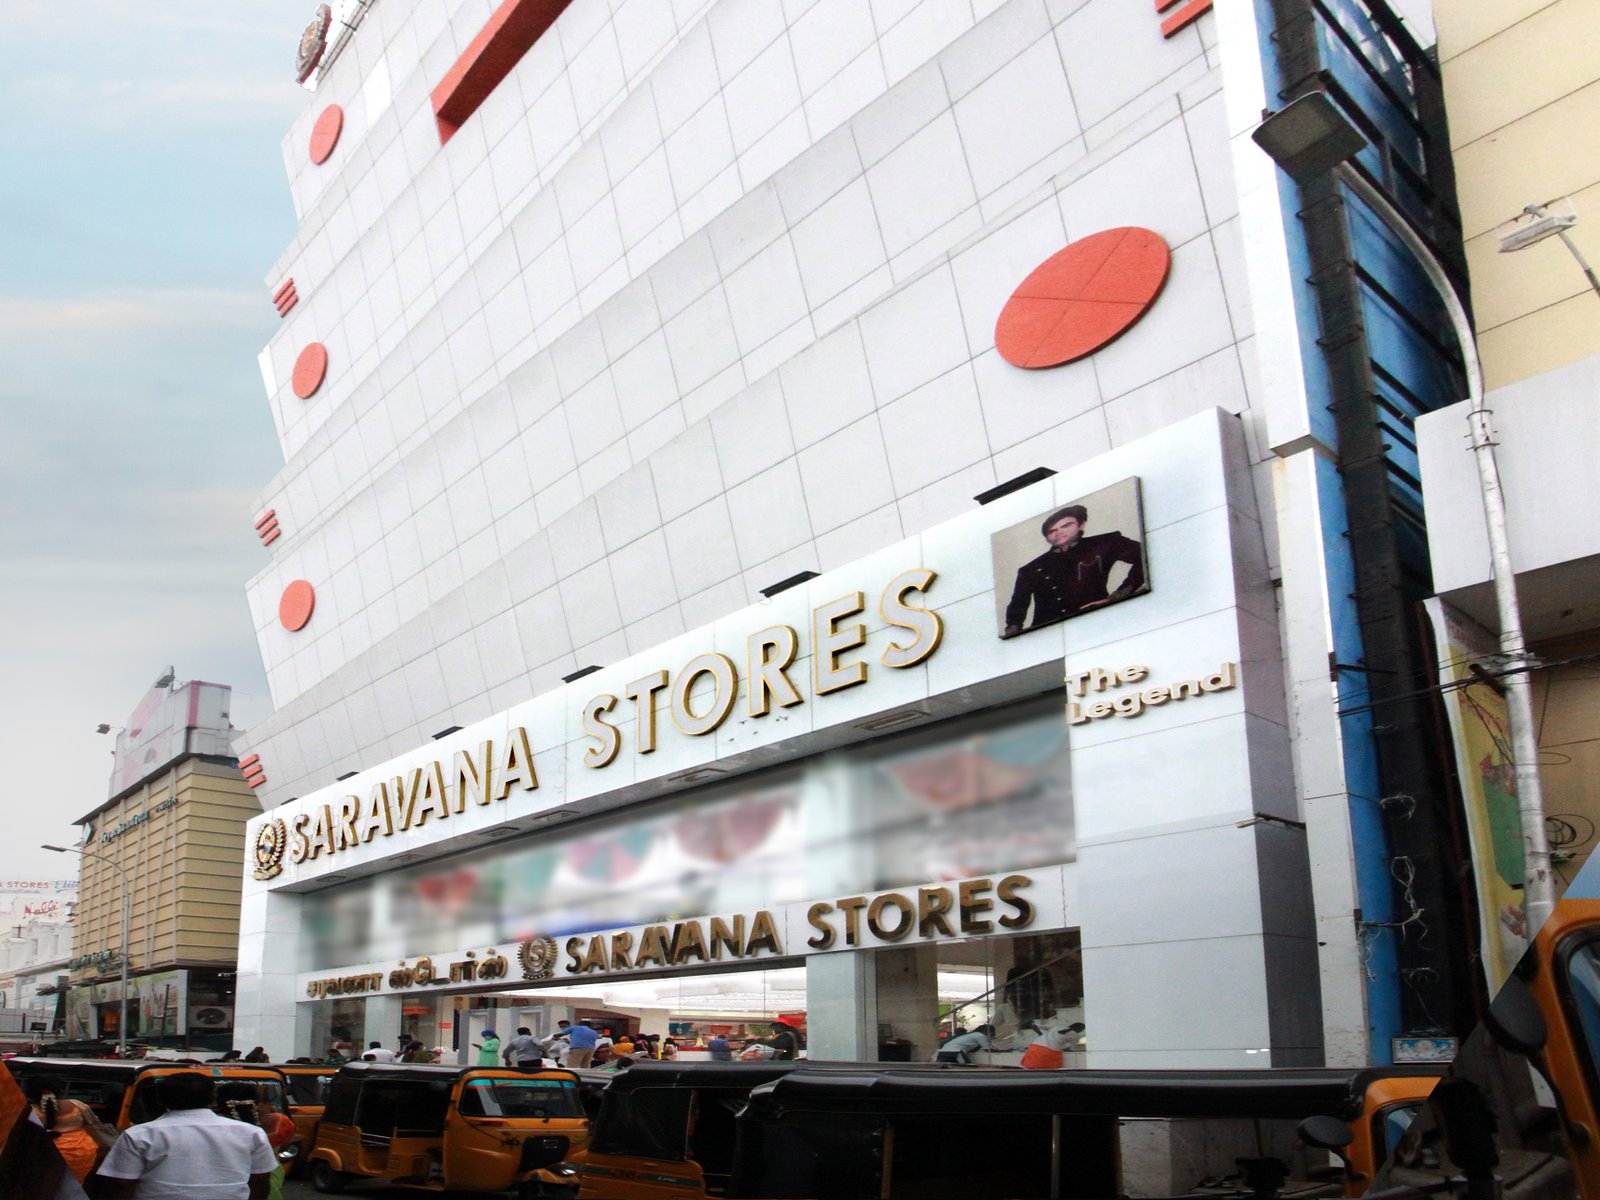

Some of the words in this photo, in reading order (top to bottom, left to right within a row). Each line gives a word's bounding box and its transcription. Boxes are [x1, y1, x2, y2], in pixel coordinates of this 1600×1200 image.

[1064, 664, 1149, 697] The
[1065, 661, 1237, 726] Legend
[289, 726, 538, 863] SARAVANA
[582, 568, 944, 769] STORES
[7, 881, 50, 889] STORES
[566, 910, 782, 973] SARAVANA
[806, 874, 1036, 950] STORES
